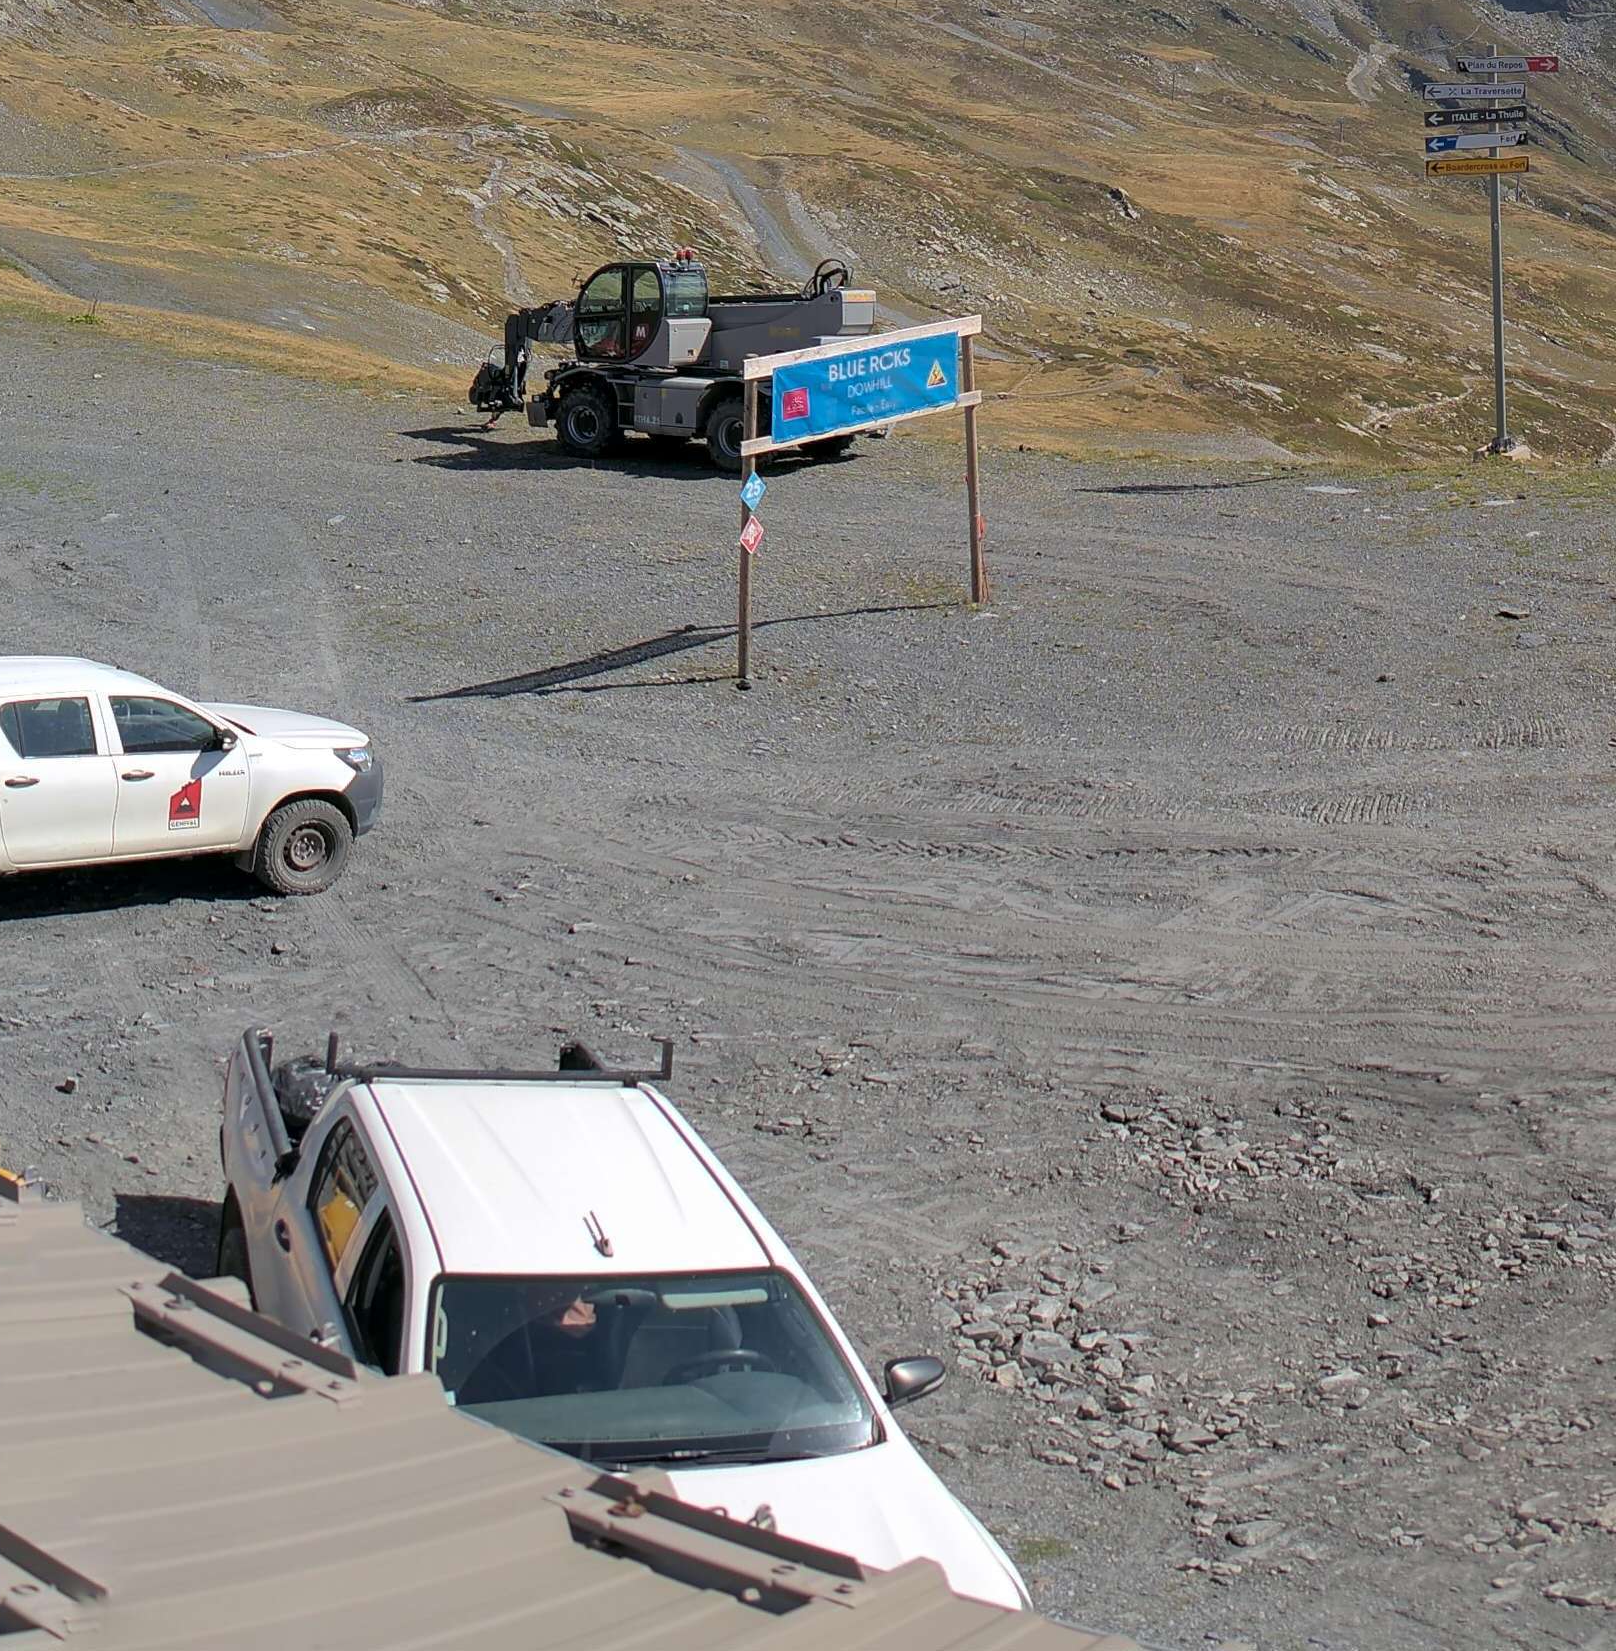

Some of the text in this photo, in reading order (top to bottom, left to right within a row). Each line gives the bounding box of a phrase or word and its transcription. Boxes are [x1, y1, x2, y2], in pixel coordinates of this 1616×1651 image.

[1467, 60, 1523, 70] Plan du Repos
[1460, 87, 1522, 95] La Traversette
[1451, 112, 1479, 122] ITALIE
[1485, 111, 1497, 120] La
[1498, 109, 1524, 119] Thuile
[1500, 134, 1517, 144] Fort
[828, 359, 866, 382] BLUE
[746, 479, 761, 499] 25
